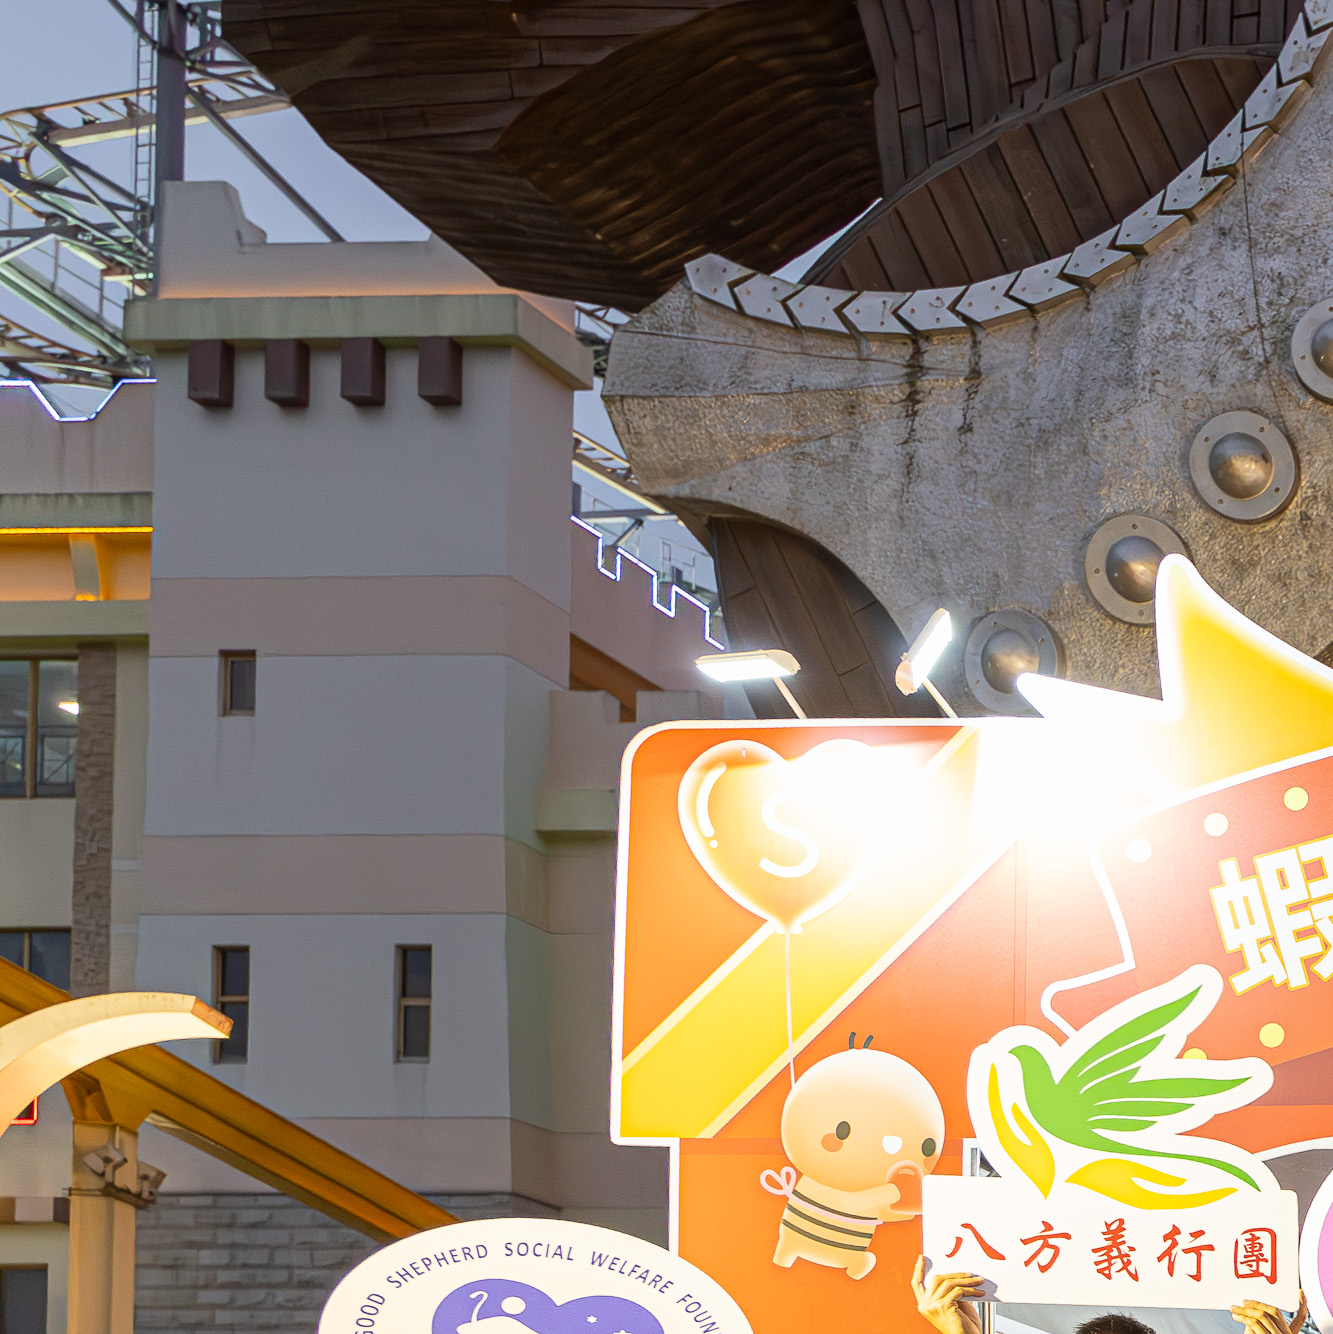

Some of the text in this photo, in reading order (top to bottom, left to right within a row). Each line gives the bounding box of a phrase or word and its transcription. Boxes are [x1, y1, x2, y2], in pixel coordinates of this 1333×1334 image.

[386, 1243, 489, 1289] SHEPHERD
[504, 1241, 575, 1262] SOCIAL
[589, 1250, 675, 1295] WELFARE
[945, 1217, 1278, 1285] 八方義行團
